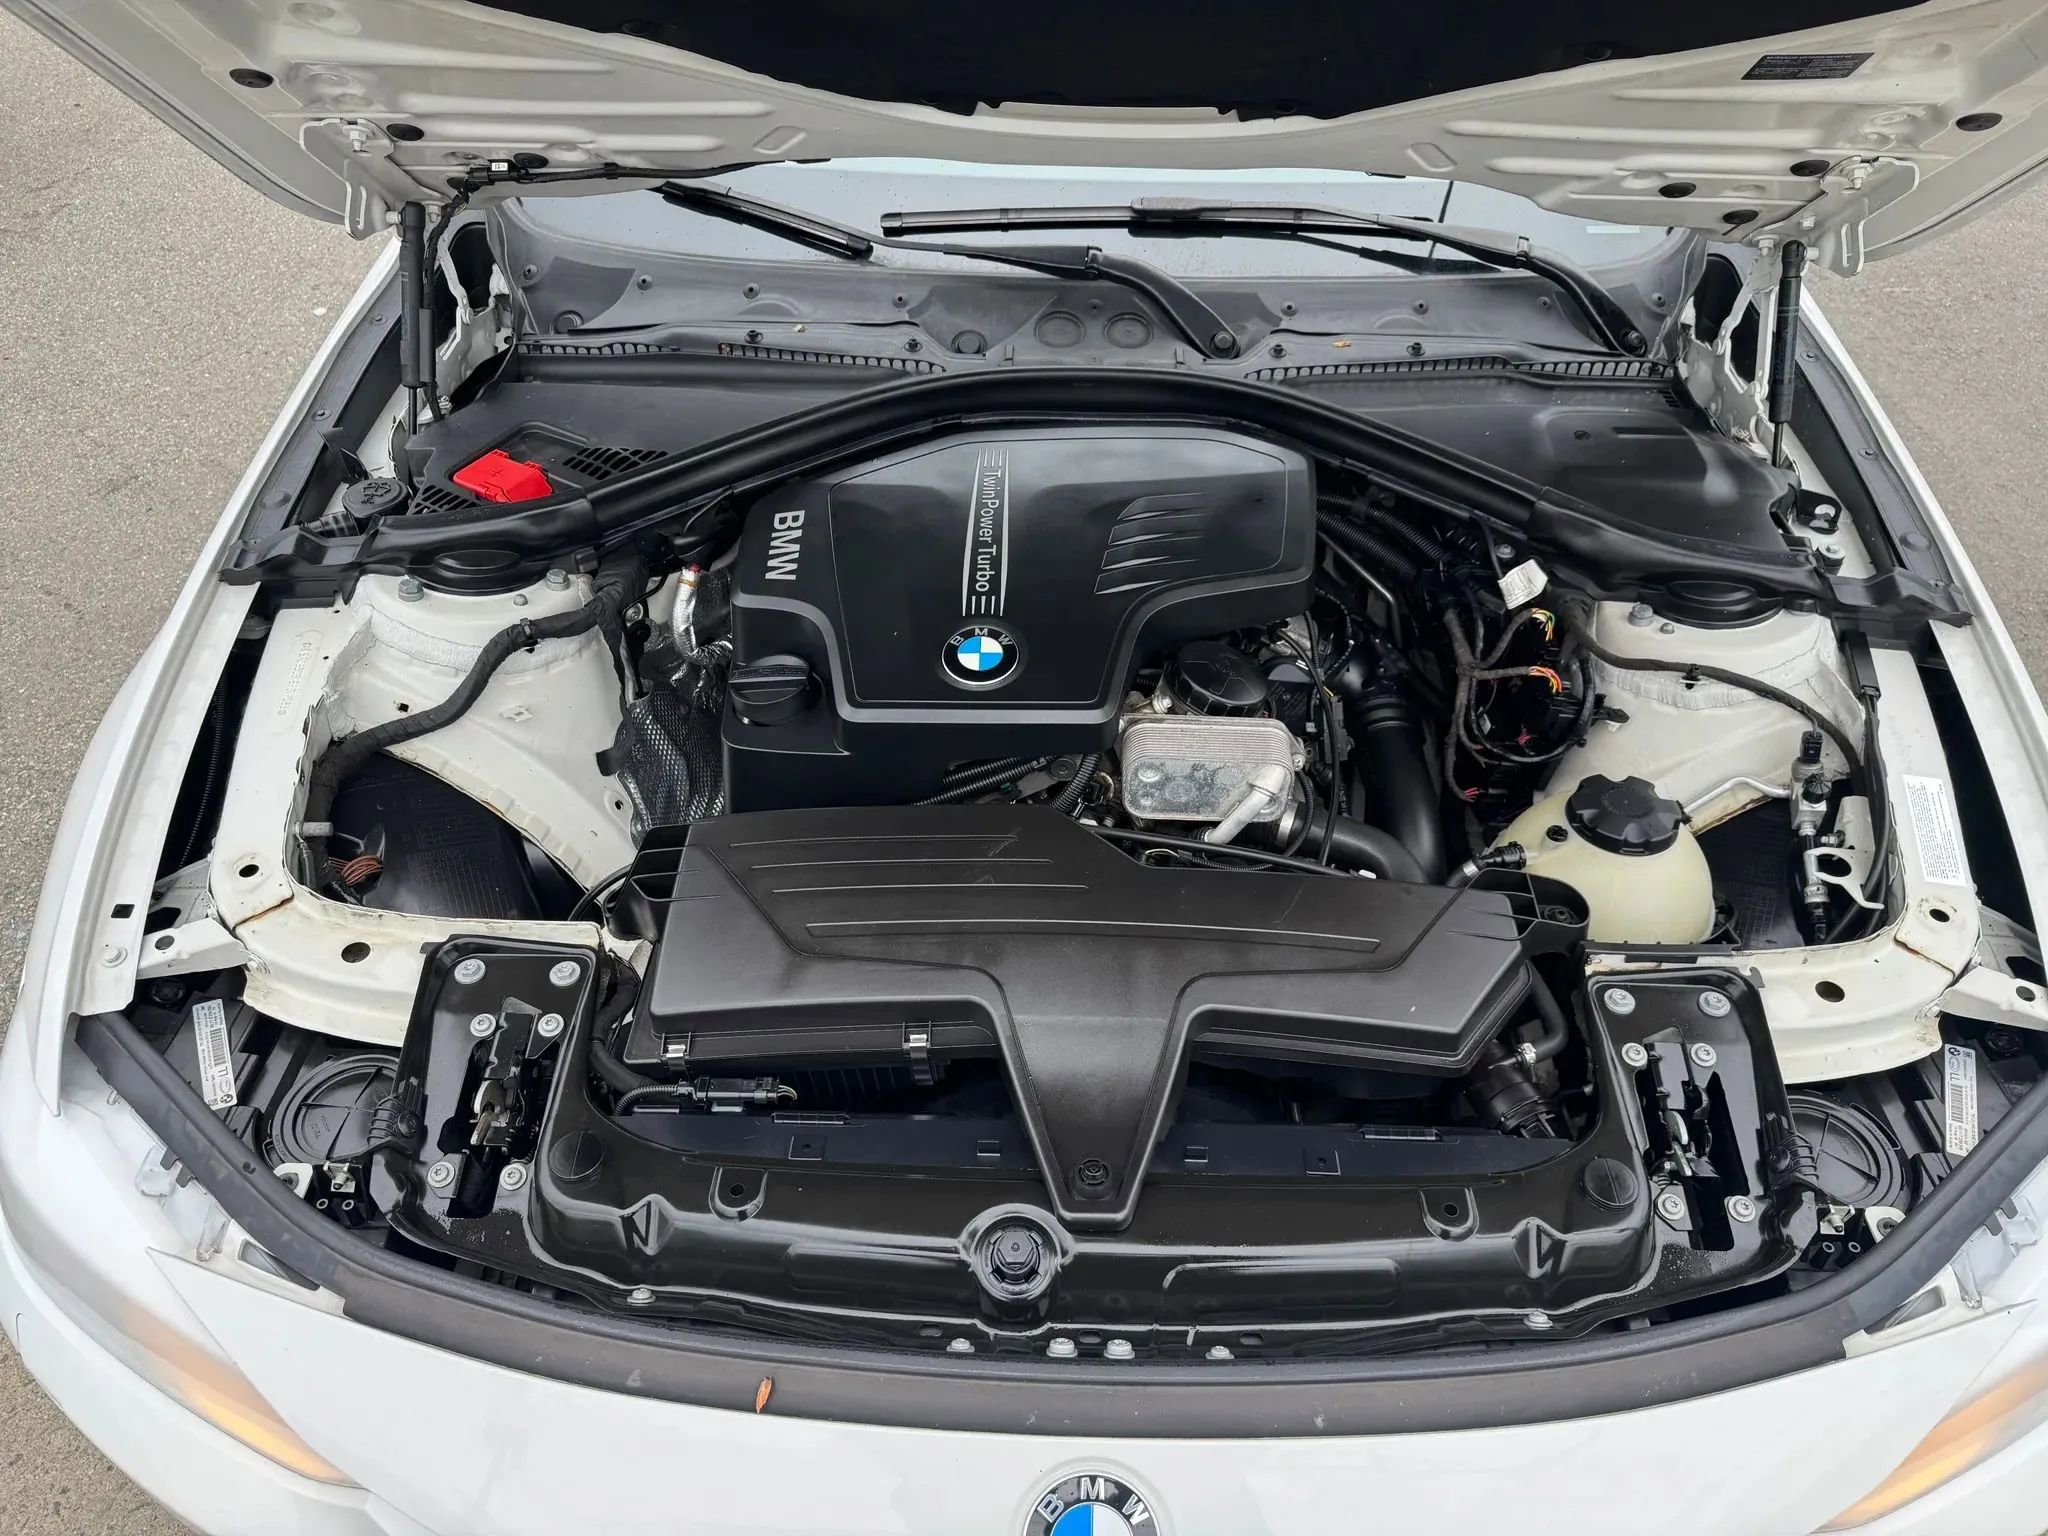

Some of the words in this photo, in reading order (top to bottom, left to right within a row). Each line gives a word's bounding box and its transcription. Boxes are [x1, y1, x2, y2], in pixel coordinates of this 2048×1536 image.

[979, 469, 1001, 543] TwinPower
[765, 510, 805, 580] BMW
[975, 545, 997, 592] Turbo
[950, 627, 1013, 646] BMW
[1037, 1477, 1150, 1526] BMW
